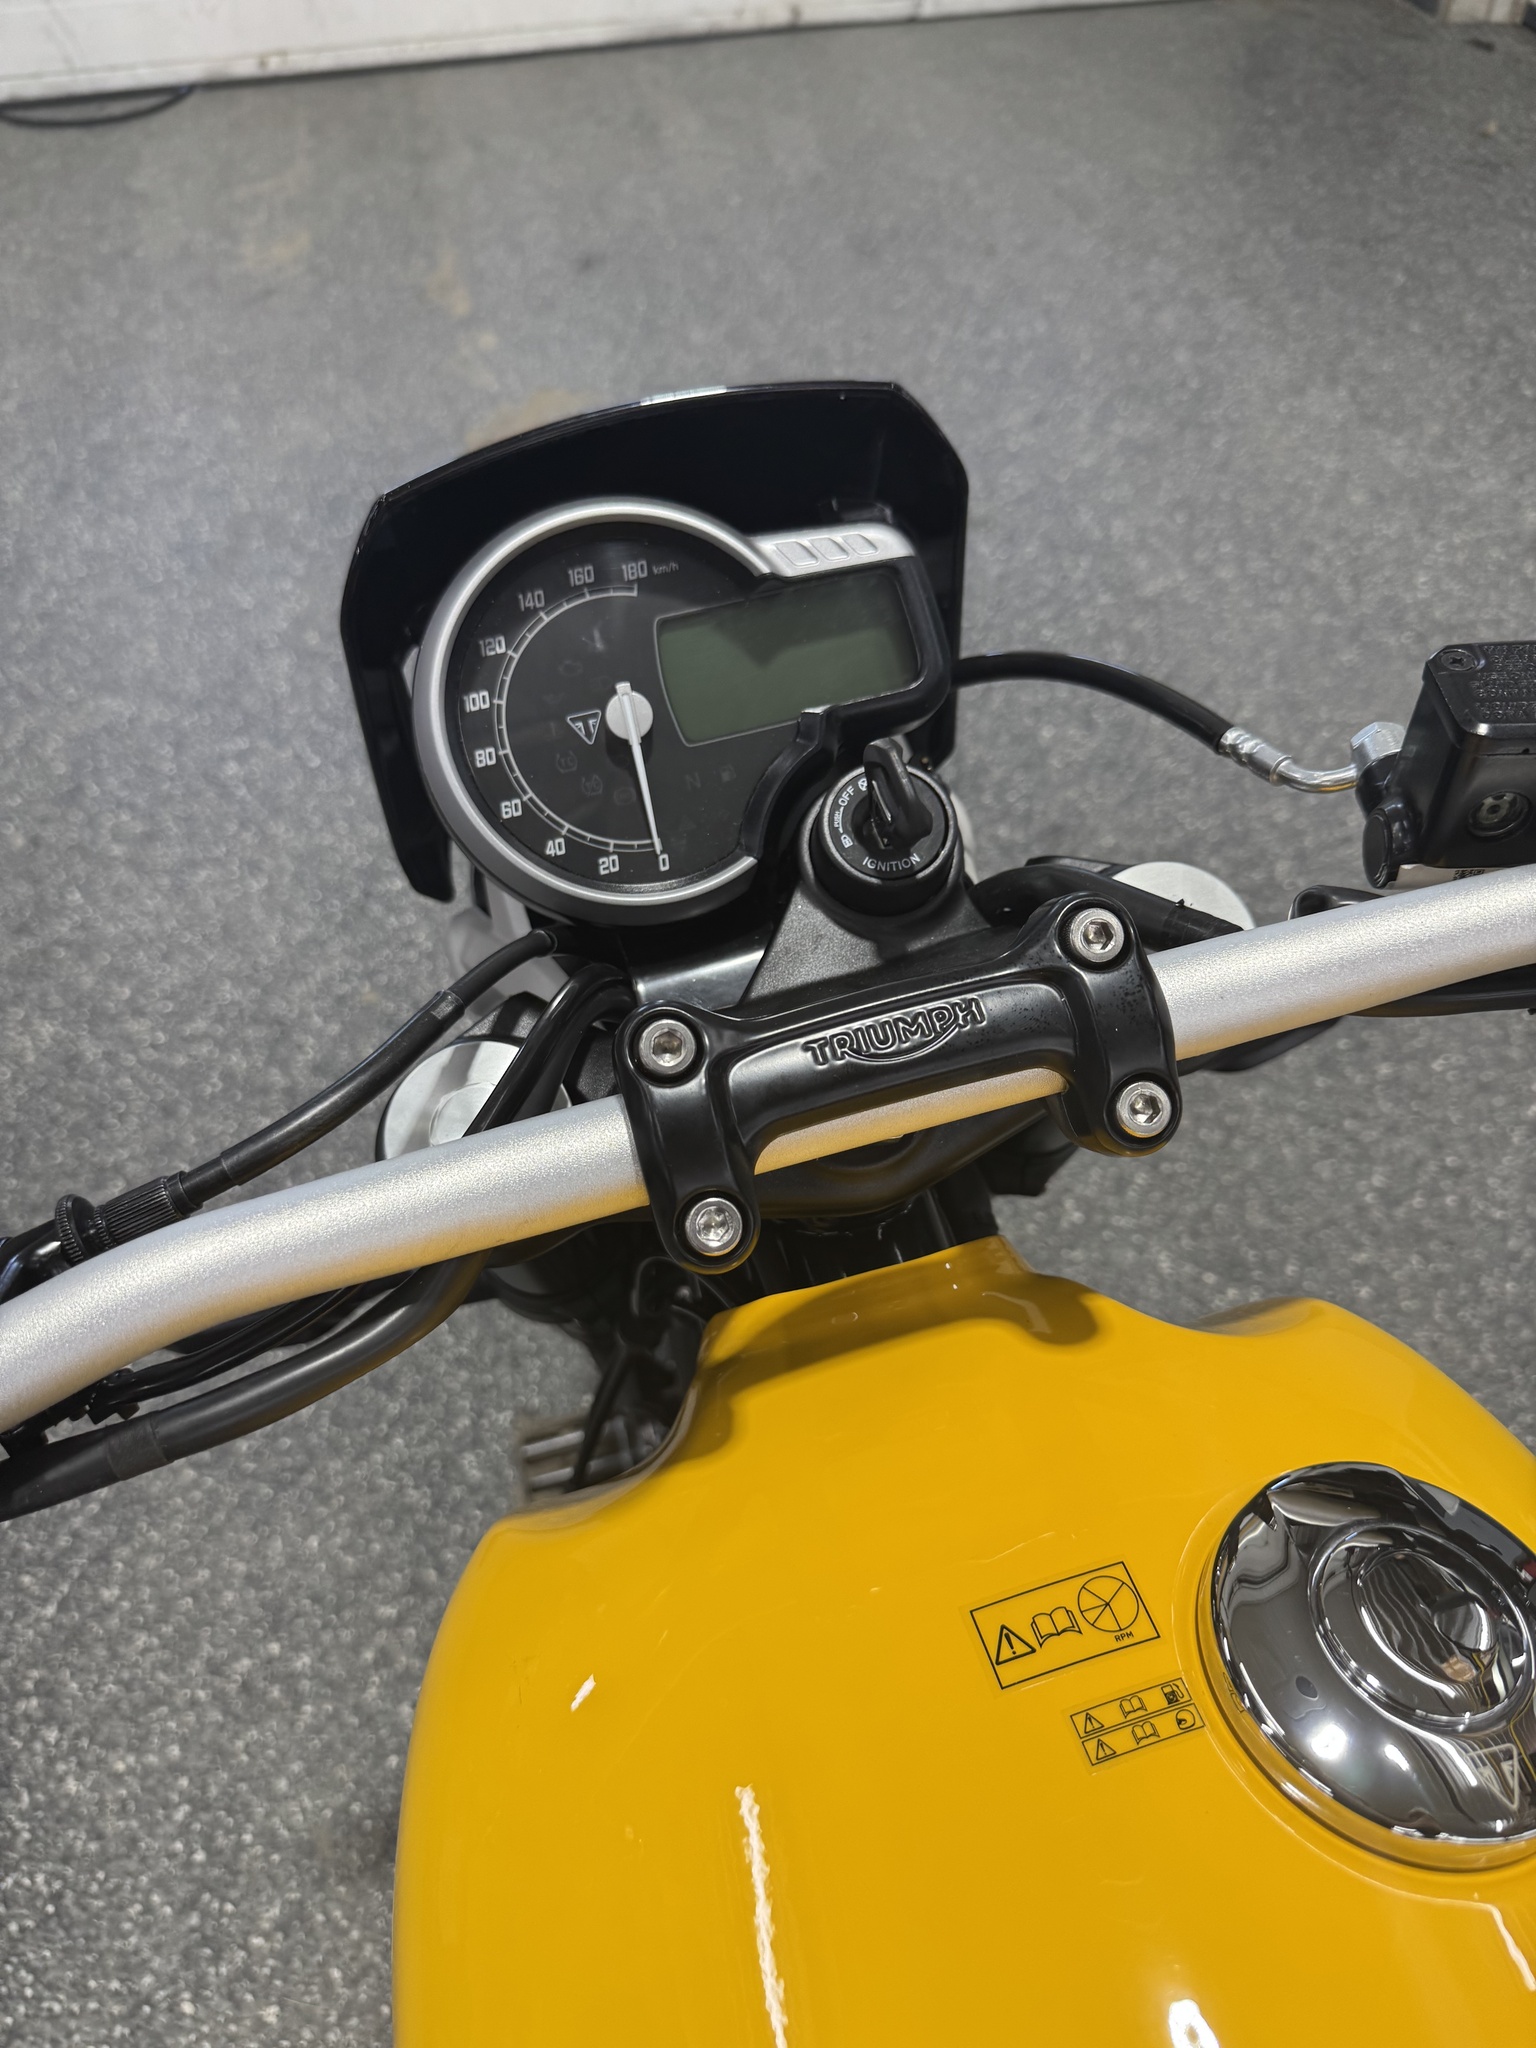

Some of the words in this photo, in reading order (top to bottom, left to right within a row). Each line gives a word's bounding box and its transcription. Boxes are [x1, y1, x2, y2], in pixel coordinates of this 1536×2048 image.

[567, 565, 595, 587] 160
[622, 560, 648, 582] 180
[652, 562, 679, 576] km/h
[518, 589, 545, 612] 140
[479, 635, 507, 657] 120
[464, 690, 490, 713] 100
[475, 747, 496, 768] 80
[838, 785, 855, 807] OFF
[501, 798, 523, 820] 60
[833, 811, 841, 828] PUSH
[545, 837, 566, 857] 40
[598, 855, 620, 875] 20
[658, 853, 670, 872] 0
[862, 853, 921, 872] IGNITION
[801, 995, 987, 1068] TRIUMPH
[1114, 1630, 1134, 1642] RPM
